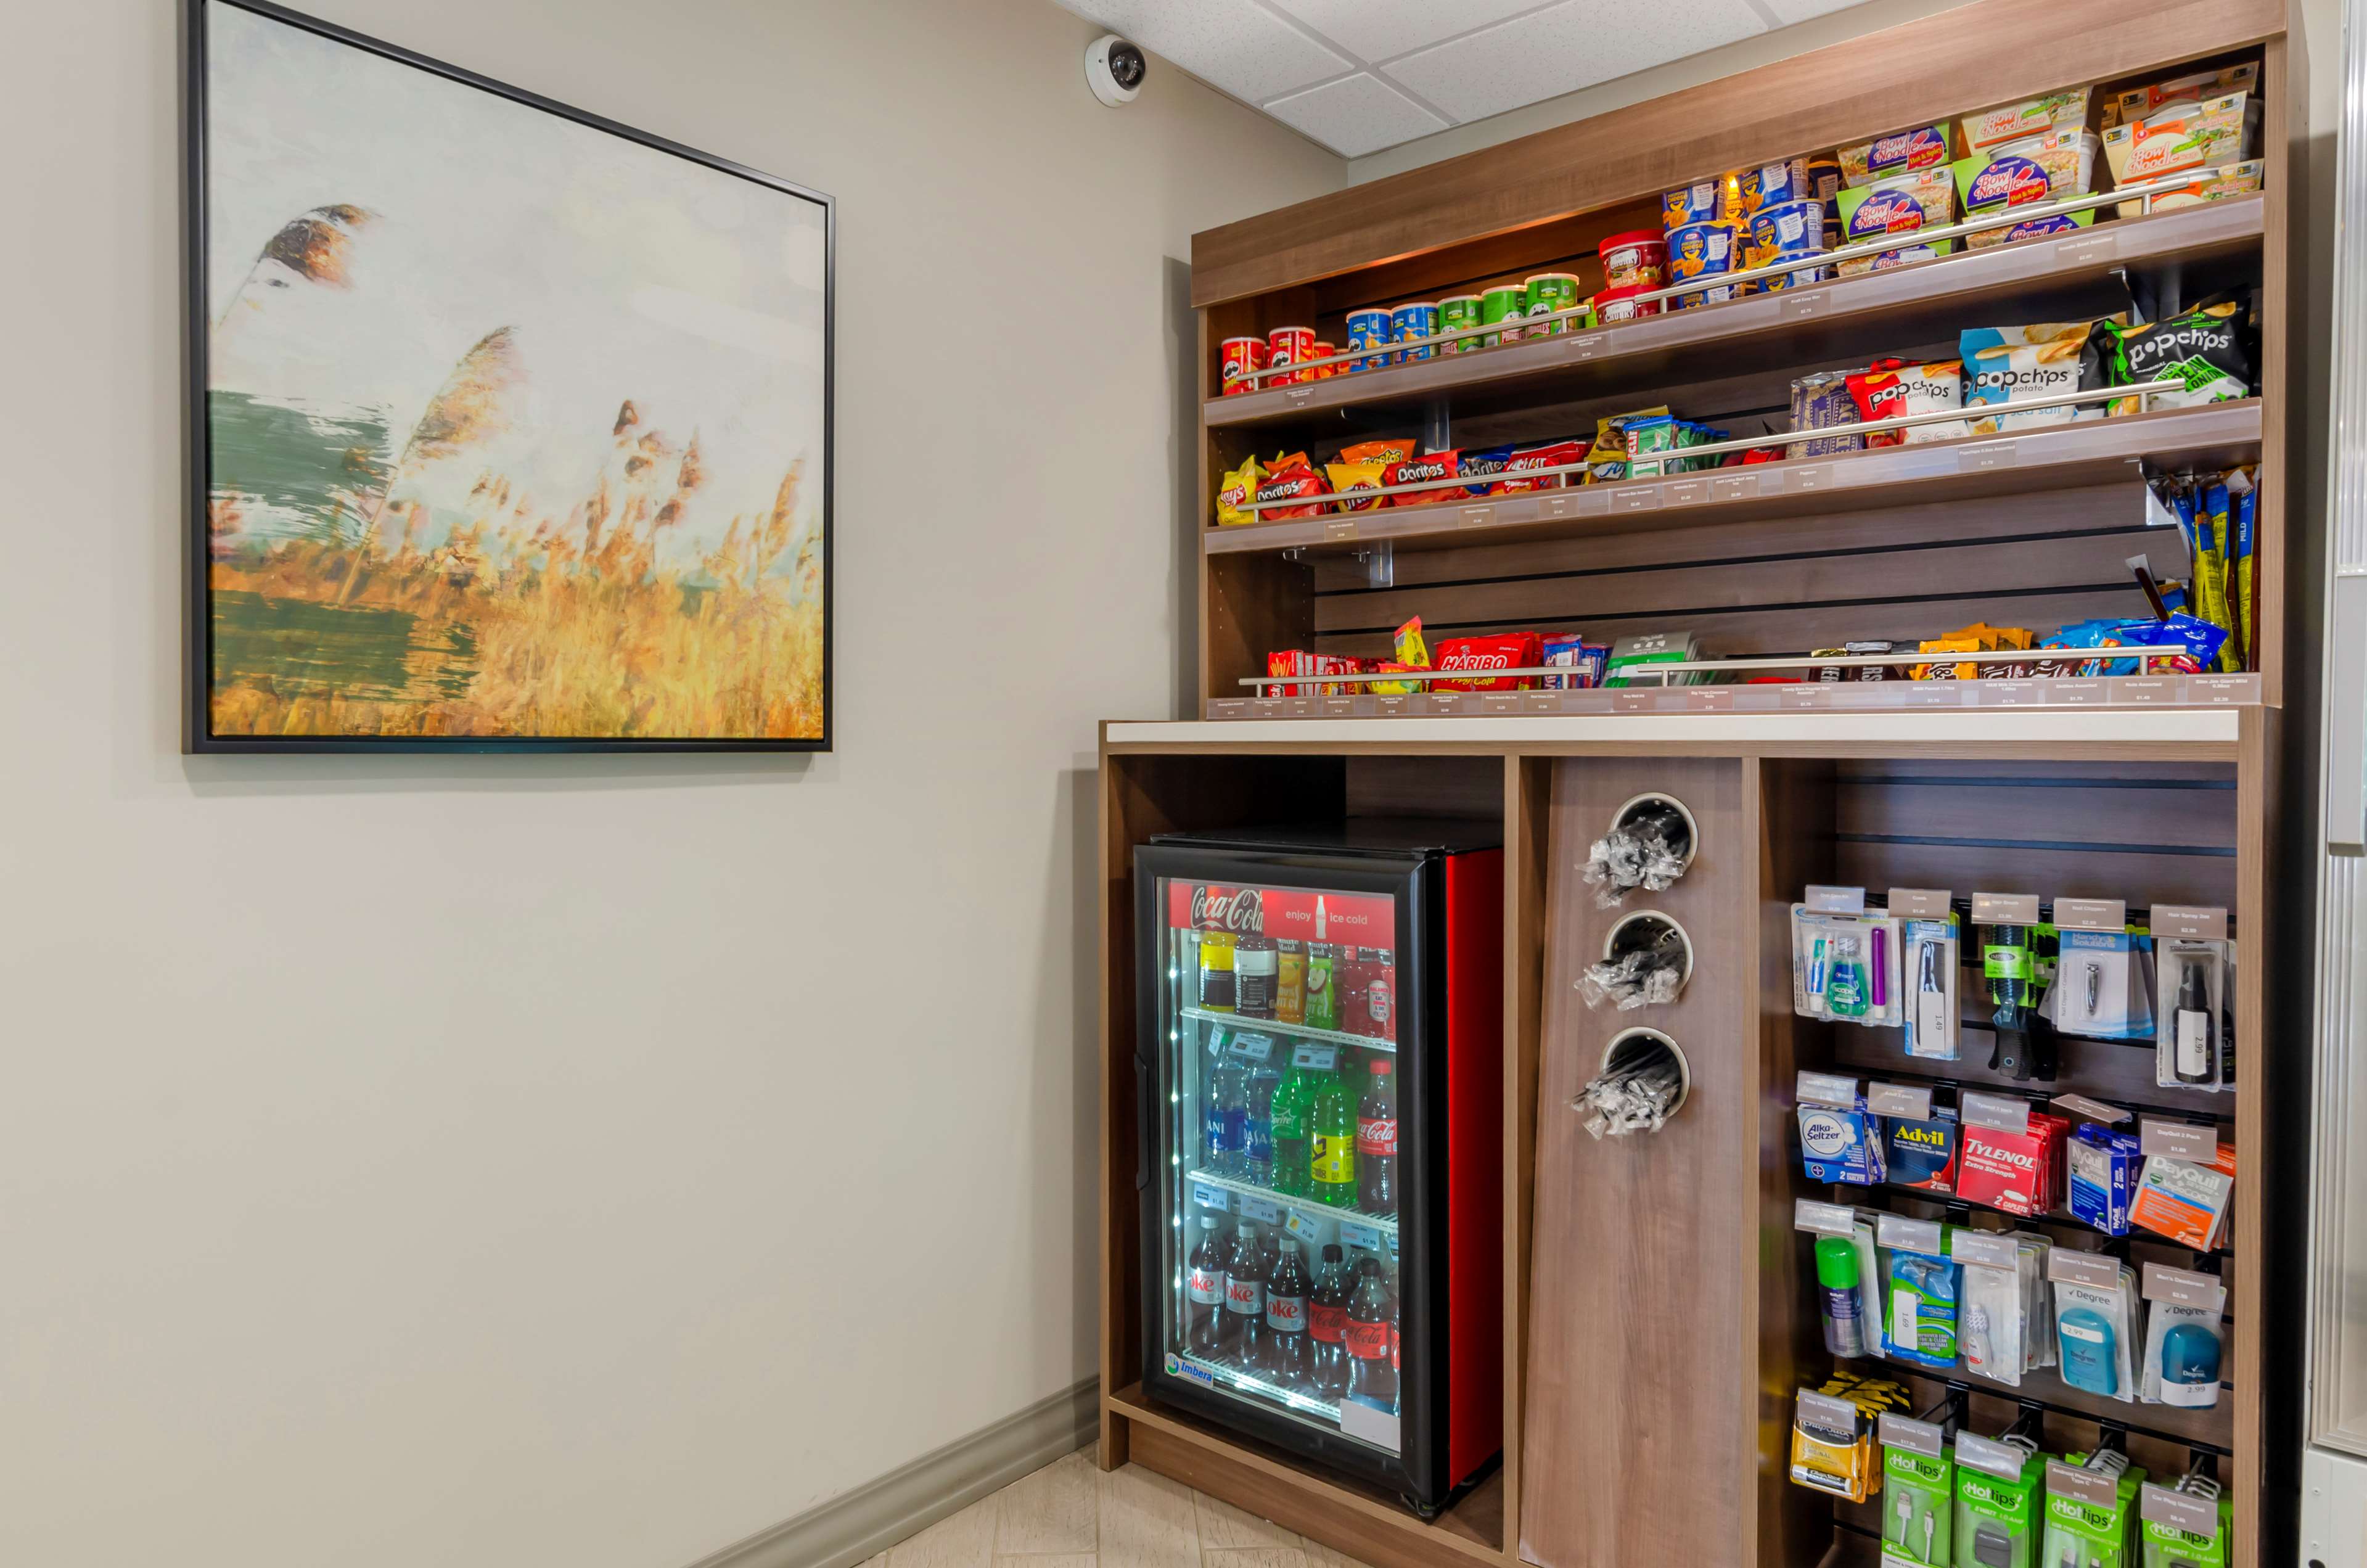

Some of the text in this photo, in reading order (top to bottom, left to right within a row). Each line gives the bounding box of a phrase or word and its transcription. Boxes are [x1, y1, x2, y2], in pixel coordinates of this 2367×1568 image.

[1984, 107, 2020, 123] Bowl
[1981, 118, 2029, 138] Noodle
[1877, 131, 1910, 149] Bowl
[1874, 142, 1919, 162] Noodle
[1909, 154, 1921, 164] Hot
[1927, 147, 1942, 158] Spicy
[2131, 142, 2171, 162] Bowl
[2128, 153, 2180, 174] Noodle
[1977, 168, 2014, 187] Bowl
[1974, 179, 2022, 200] Noodle
[2011, 192, 2022, 202] Hot
[2028, 185, 2043, 197] Spicy
[1858, 200, 1892, 218] Bowl
[1855, 211, 1898, 229] Noodle
[1889, 223, 1900, 232] Hot
[1905, 218, 1919, 228] Spicy
[2011, 226, 2048, 241] Bowl
[1876, 258, 1906, 269] Bow
[2130, 329, 2228, 370] popchips
[2171, 356, 2209, 380] REAM
[1974, 369, 2068, 393] popchips
[2012, 385, 2043, 393] potato
[1869, 380, 1950, 412] popchips
[1908, 392, 1929, 400] pota
[1398, 463, 1445, 482] Doritos
[1257, 481, 1300, 501] Doritos
[1440, 654, 1508, 671] HARIBO
[1191, 887, 1368, 932] Coca-Cola enjoy ice cold
[2072, 933, 2104, 944] Handy
[2072, 938, 2115, 948] Solutions
[2195, 1036, 2204, 1053] 2.99
[1206, 1119, 1225, 1135] ANI
[1807, 1131, 1840, 1141] Seltzer
[1809, 1124, 1834, 1133] Alka-
[1895, 1125, 1943, 1146] Advil
[2157, 1129, 2180, 1137] DayQuil
[1966, 1138, 2037, 1169] TYLENOL
[2072, 1145, 2103, 1170] NyQuil
[1839, 1171, 1845, 1180] 2
[1965, 1160, 1983, 1170] Extra
[1985, 1165, 2017, 1179] Strength
[2152, 1157, 2220, 1191] DayQuil
[1994, 1196, 2029, 1213] 2 CAPLETS
[2094, 1217, 2098, 1226] 2
[2175, 1231, 2185, 1241] 2
[1191, 1274, 1215, 1292] oke
[1226, 1283, 1253, 1302] oke
[2077, 1290, 2111, 1305] Degree
[1267, 1300, 1298, 1318] oke
[2173, 1307, 2207, 1317] Degree
[2067, 1327, 2083, 1336] 2.99
[2070, 1350, 2096, 1363] Degree
[1181, 1361, 1212, 1382] Imbera
[2187, 1385, 2205, 1394] 2.99
[1893, 1453, 1938, 1477] Hottips
[1967, 1482, 2016, 1506] Hottips
[2056, 1499, 2108, 1527] Hottips
[1885, 1543, 1892, 1551] 4
